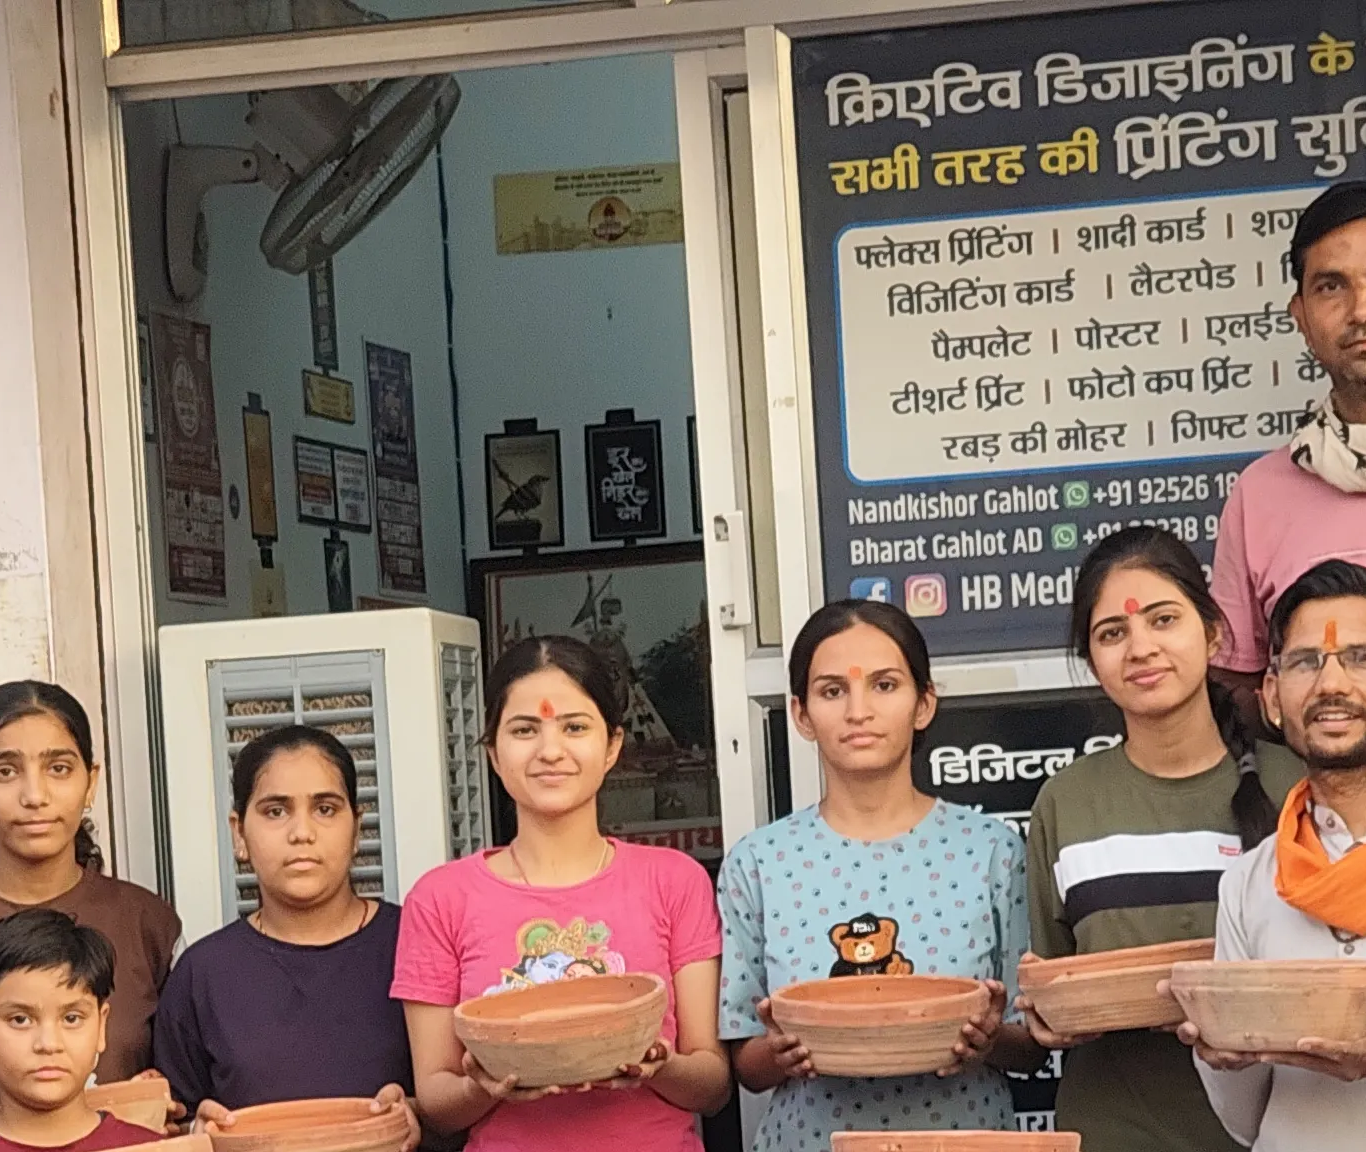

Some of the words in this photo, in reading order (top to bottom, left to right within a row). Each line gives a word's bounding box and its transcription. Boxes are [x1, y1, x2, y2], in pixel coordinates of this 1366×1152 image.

[826, 62, 1022, 128] क्रिएटिव
[1034, 33, 1294, 108] डिजाइनिंग
[1308, 33, 1354, 77] के
[830, 143, 920, 197] सभी
[934, 143, 1025, 188] तरह
[1038, 128, 1099, 176] की
[854, 228, 941, 271] फ्लेक्स
[1077, 212, 1136, 254] शादी
[1146, 206, 1207, 246] कार्ड
[888, 276, 1008, 318] विजिटिंग
[1015, 268, 1075, 307] कार्ड
[1130, 257, 1236, 297] लैटरपेड
[932, 323, 1032, 364] पैम्पलेट
[1075, 314, 1161, 352] पोस्टर
[1205, 301, 1300, 346] एलईड
[890, 376, 967, 417] टीशर्ट
[1068, 364, 1137, 403] फोटो
[1144, 368, 1193, 398] कप
[941, 431, 1001, 463] रबड़
[1009, 420, 1048, 455] की
[1055, 418, 1128, 453] मोहर
[1171, 412, 1248, 445] गिफ्ट
[848, 490, 978, 525] Nandkishor
[983, 484, 1060, 515] Gahlot
[1093, 479, 1132, 507] +91
[1138, 474, 1209, 505] 92526
[850, 533, 926, 566] Bharat
[932, 529, 1007, 560] Gahlot
[1013, 529, 1043, 555] AD
[961, 574, 1002, 612] HB
[1011, 566, 1080, 608] Med
[929, 743, 1076, 786] डिजिटल
